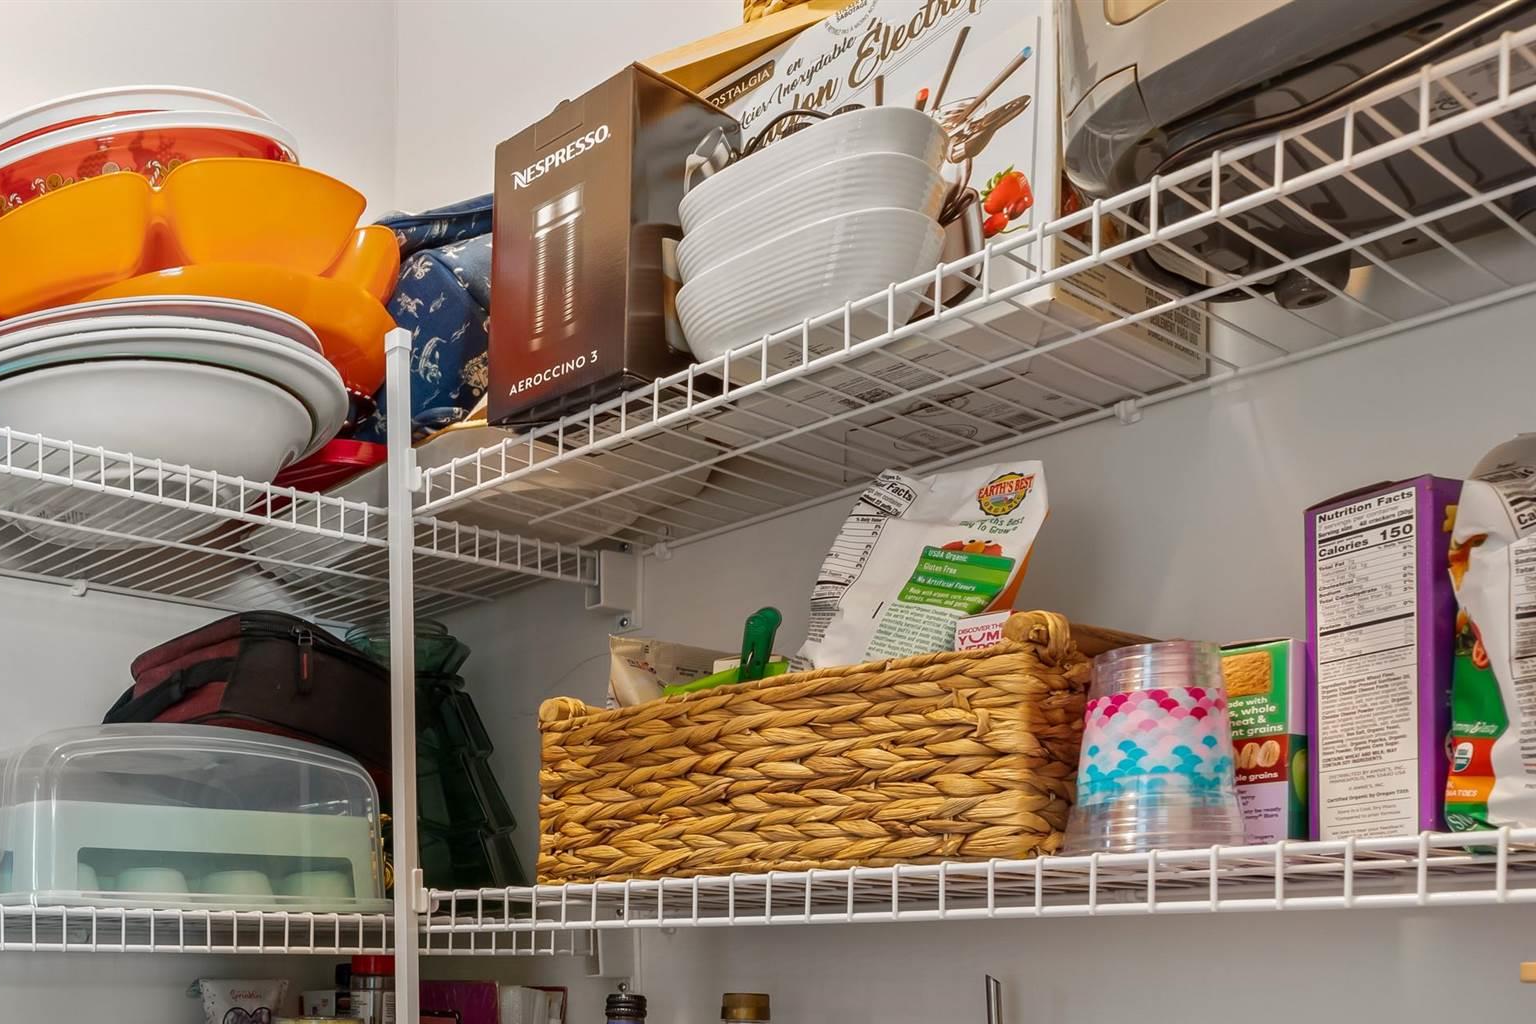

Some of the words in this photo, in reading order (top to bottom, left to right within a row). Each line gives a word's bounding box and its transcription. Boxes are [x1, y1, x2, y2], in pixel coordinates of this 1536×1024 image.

[511, 125, 610, 191] NESPRESSO
[509, 358, 586, 397] AEROCCINO
[590, 349, 599, 365] 3
[978, 480, 1013, 499] EARTH'S
[1014, 475, 1034, 491] BEST
[1318, 502, 1372, 523] Nutrition
[1377, 491, 1413, 506] Facts
[1319, 539, 1368, 557] Calories
[1380, 523, 1413, 540] 150
[923, 563, 942, 572] Gluten
[958, 626, 991, 635] DISCOVER
[958, 630, 1000, 644] YUM
[1241, 704, 1276, 714] whole
[1247, 724, 1283, 737] grains
